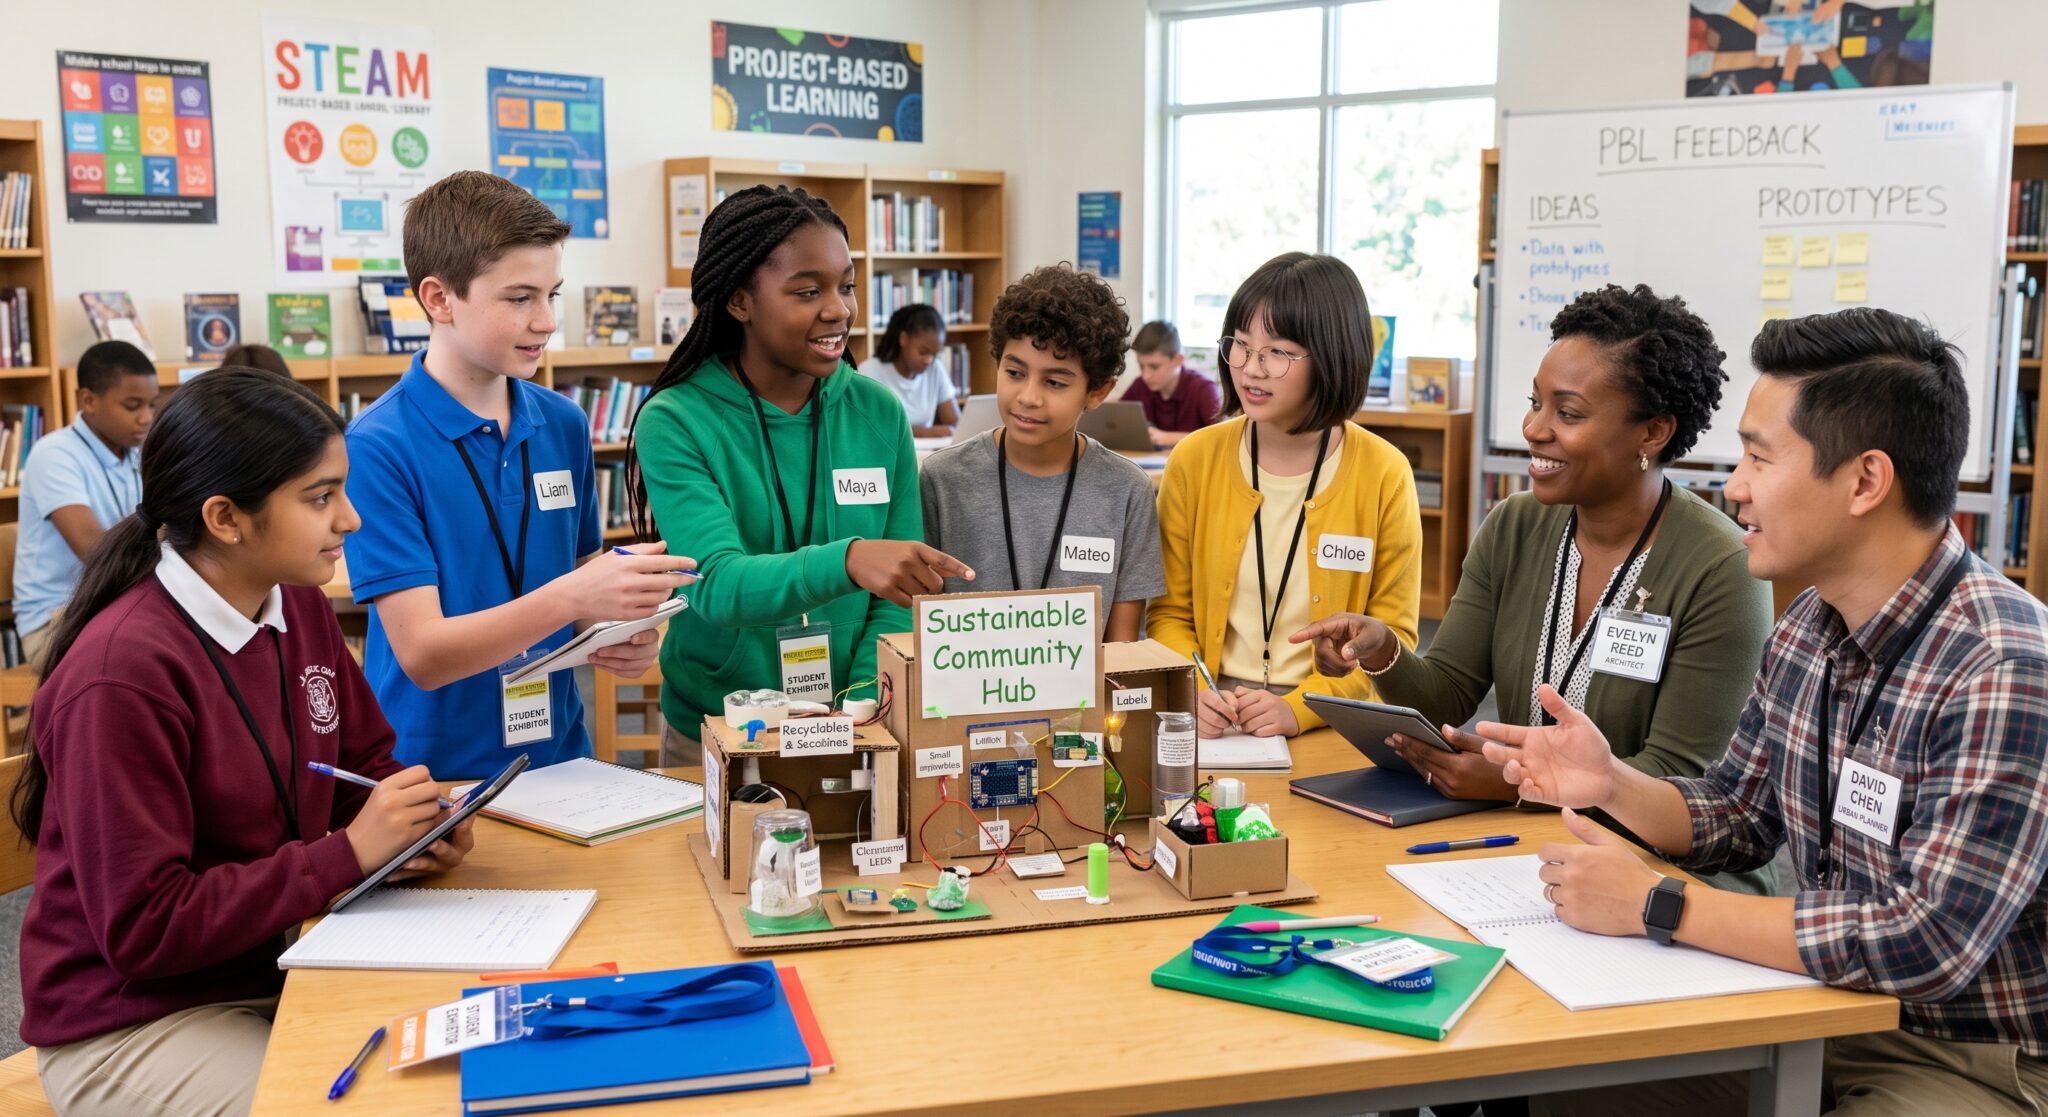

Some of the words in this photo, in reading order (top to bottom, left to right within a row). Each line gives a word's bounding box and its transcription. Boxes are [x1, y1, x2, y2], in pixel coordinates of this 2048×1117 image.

[275, 40, 429, 100] STEAM
[728, 44, 909, 90] PROJECT-BASED
[766, 83, 879, 120] LEARNING
[1600, 126, 1658, 165] PBL
[1674, 124, 1822, 160] FEEDBACK
[1529, 194, 1599, 221] IDEAS
[1758, 185, 1948, 218] PROTOTYPES
[1530, 238, 1565, 256] Data
[1572, 240, 1604, 255] with
[540, 482, 569, 498] Liam
[838, 479, 877, 497] Maya
[1064, 545, 1111, 562] Mateo
[1322, 544, 1366, 562] Chloe
[927, 600, 1087, 634] Sustainable
[1607, 626, 1657, 645] EVELYN
[933, 639, 1083, 670] Community
[1610, 642, 1645, 658] REED
[1605, 657, 1645, 670] ARCHITECT
[788, 672, 827, 685] STUDENT
[786, 682, 830, 695] EXHIBITOR
[982, 676, 1036, 705] Hub
[1116, 694, 1148, 706] Labels
[508, 708, 546, 722] STUDENT
[507, 718, 549, 732] EXHIBITOR
[782, 721, 850, 738] Recyclables
[785, 740, 794, 750] &
[929, 750, 951, 760] Small
[1851, 770, 1887, 795] DAVID
[1850, 790, 1883, 815] CHEN
[1838, 804, 1859, 820] URBAN
[1859, 813, 1889, 834] PLANNER
[869, 856, 892, 867] LEDS
